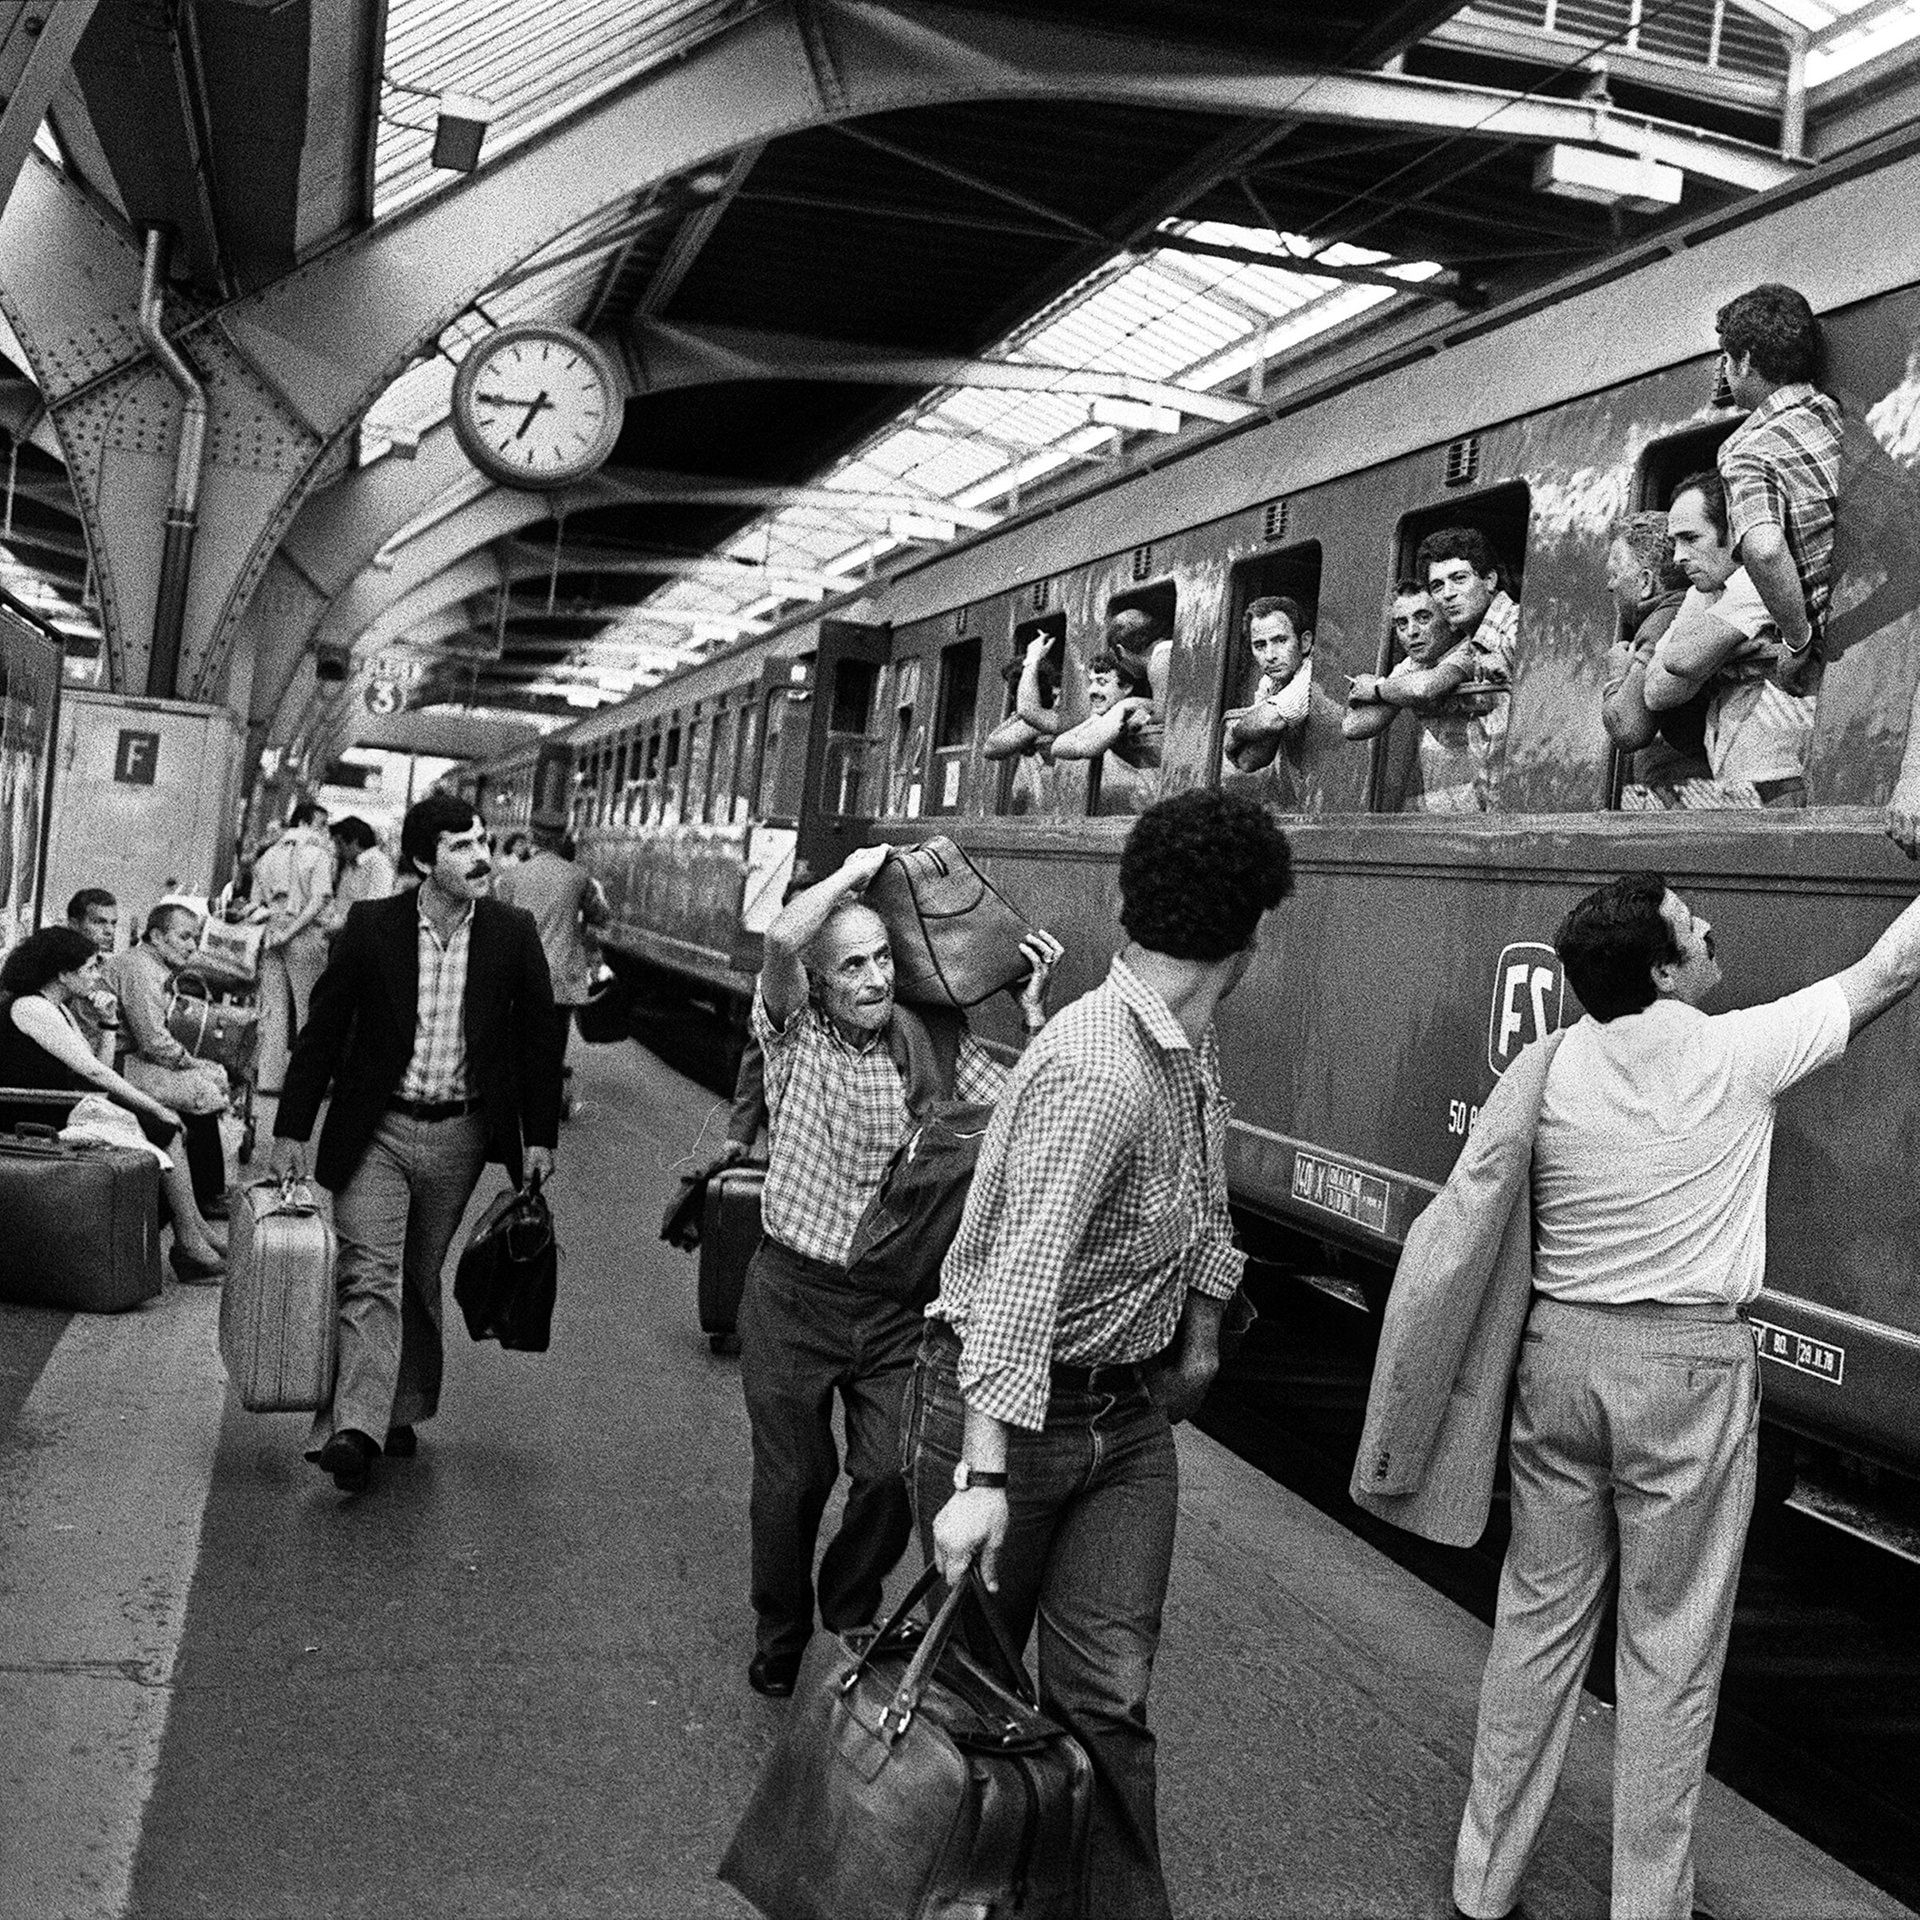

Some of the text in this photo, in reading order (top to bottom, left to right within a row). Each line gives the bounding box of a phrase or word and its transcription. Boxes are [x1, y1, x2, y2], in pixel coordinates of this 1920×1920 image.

[371, 680, 395, 714] 3
[127, 739, 149, 775] F
[1498, 964, 1553, 1057] FS
[1448, 1099, 1467, 1135] 50
